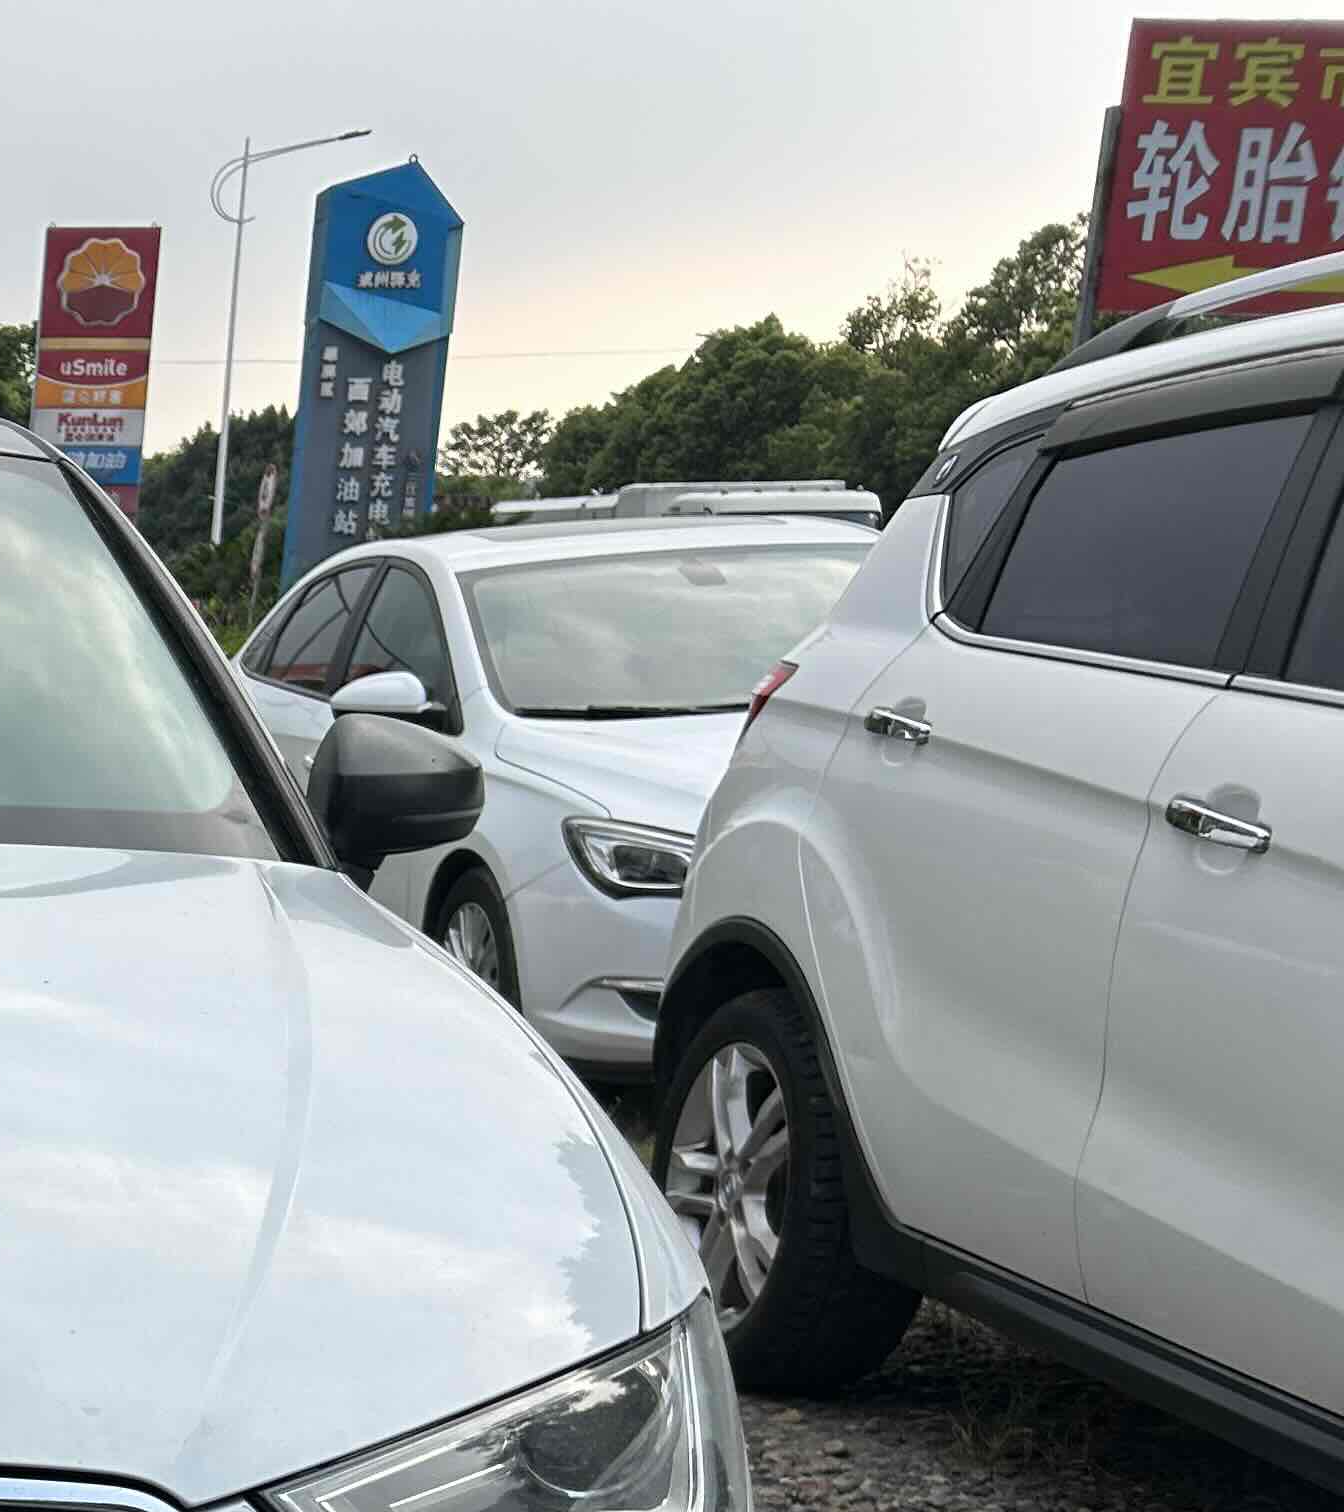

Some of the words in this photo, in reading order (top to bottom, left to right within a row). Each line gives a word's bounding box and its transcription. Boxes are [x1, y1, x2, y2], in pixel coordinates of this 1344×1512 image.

[1126, 119, 1344, 244] 轮胎
[60, 358, 128, 377] uSmile
[332, 376, 373, 535] 西郊加油站
[365, 360, 405, 541] 电动汽车充电
